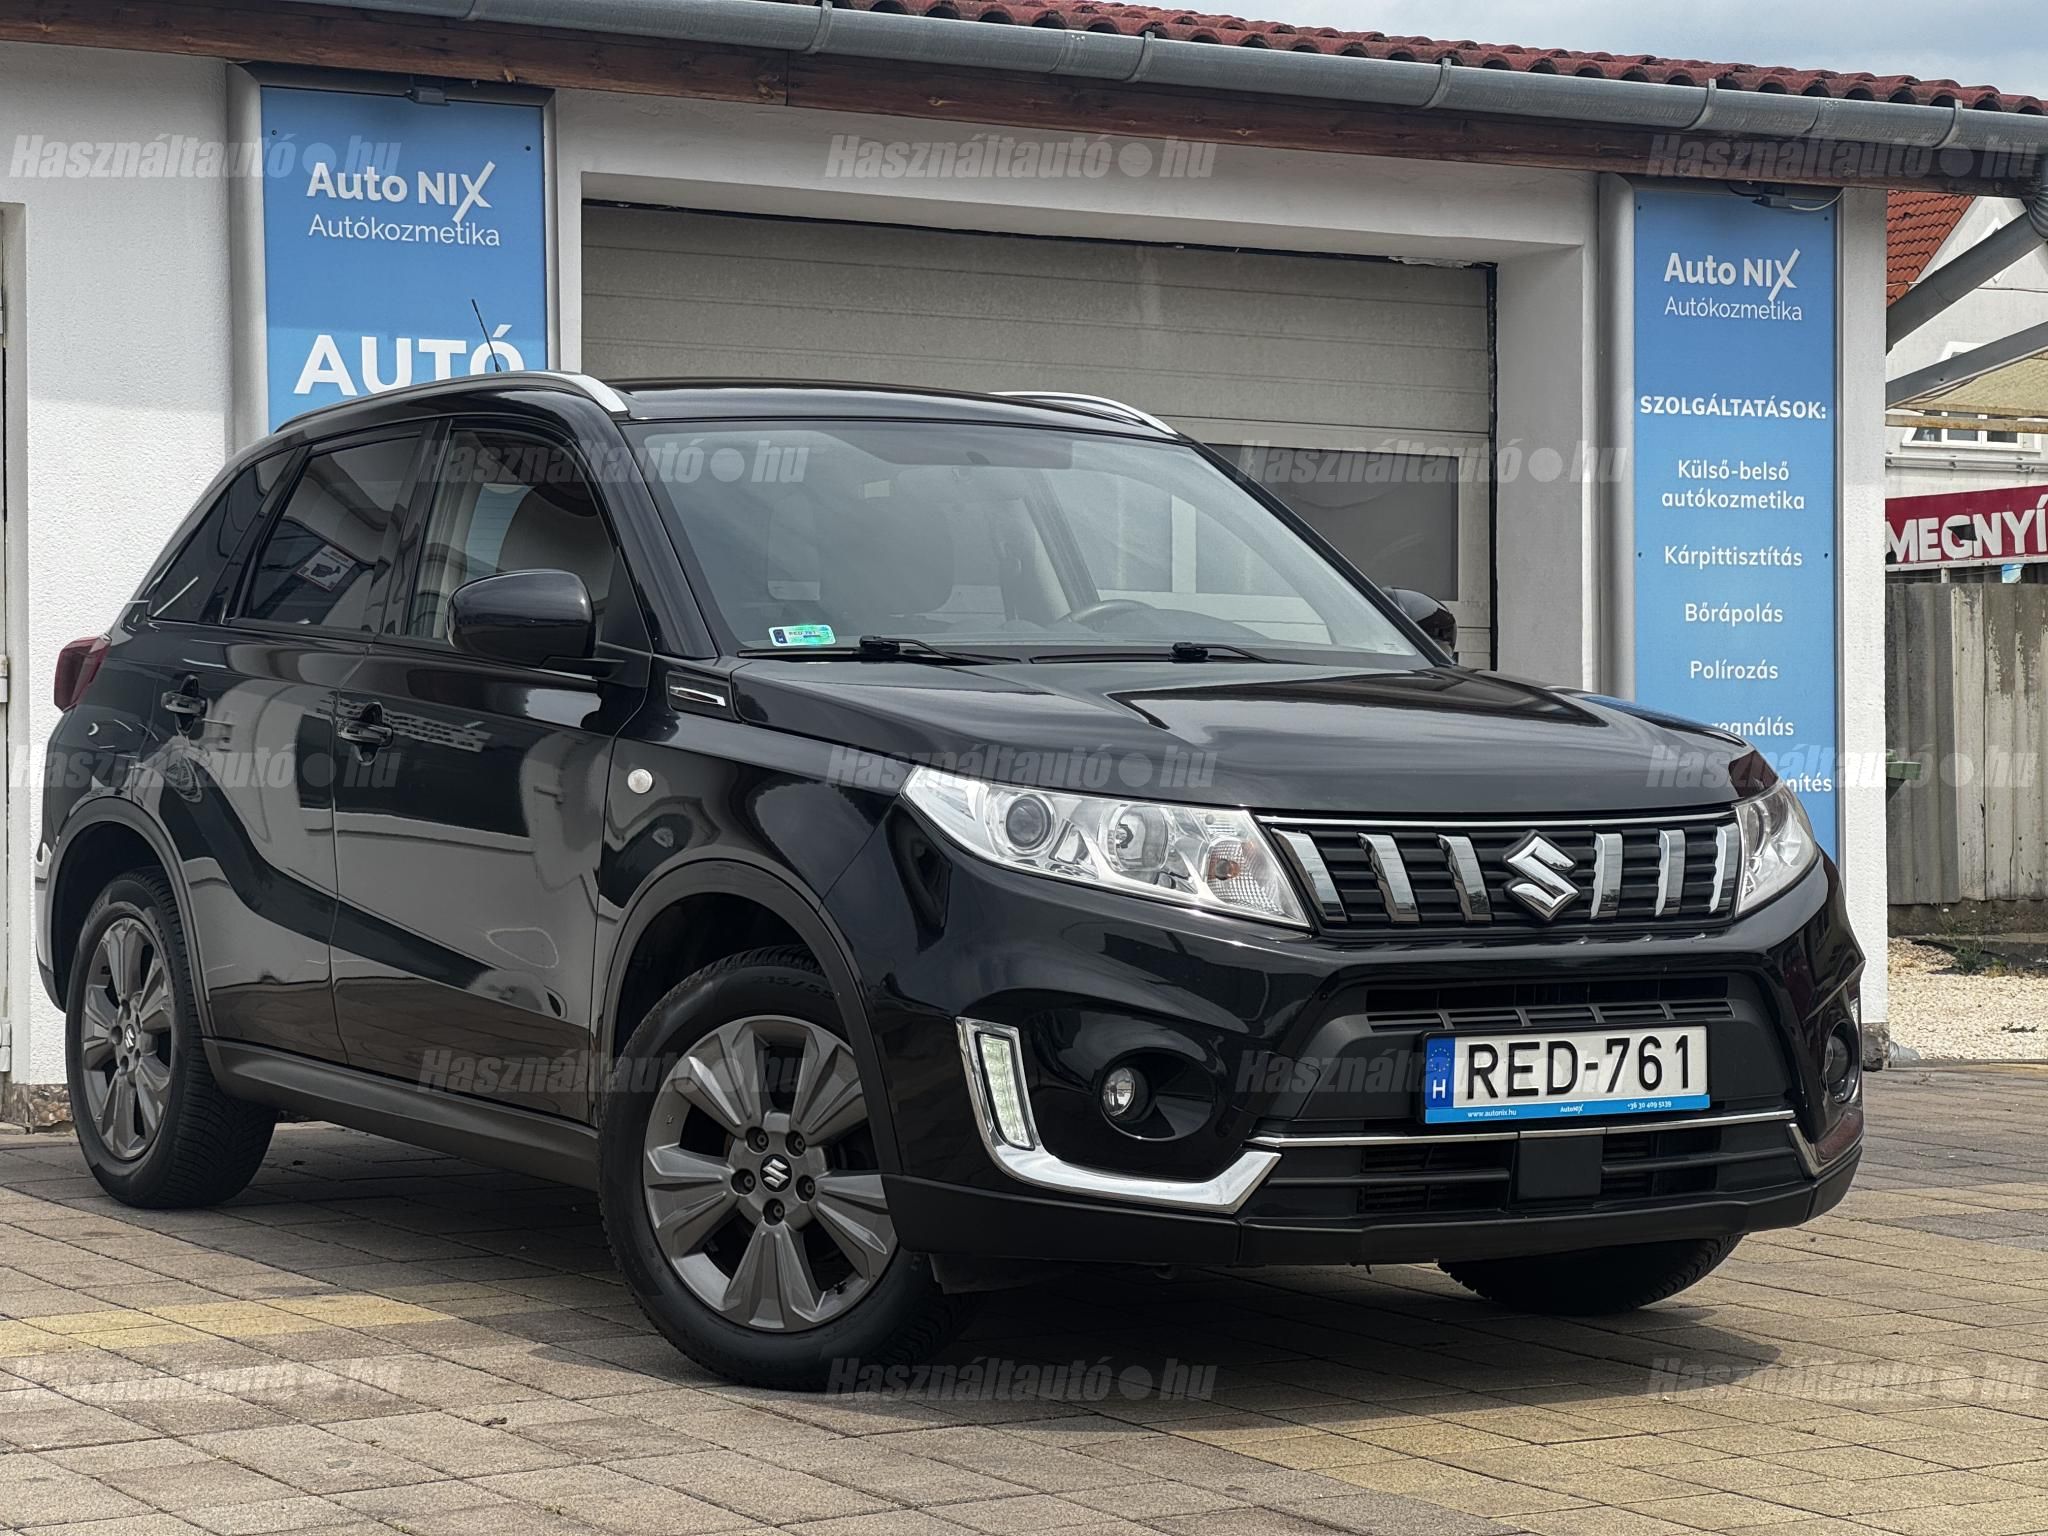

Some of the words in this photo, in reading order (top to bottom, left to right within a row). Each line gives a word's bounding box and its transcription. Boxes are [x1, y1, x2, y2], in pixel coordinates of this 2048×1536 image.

[306, 162, 408, 203] Auto
[417, 160, 496, 224] NIX
[308, 214, 501, 246] Autókozmetika
[1663, 252, 1737, 286] Auto
[1743, 248, 1801, 301] NIX
[1664, 295, 1803, 321] Autókozmetika
[293, 324, 525, 396] AUTÓ
[1640, 393, 1827, 419] SZOLGÁLTATÁSOK:
[1678, 459, 1790, 481] Külső-belső
[1661, 487, 1806, 510] autókozmetika
[1664, 544, 1804, 570] Kárpittisztítás
[1685, 602, 1784, 627] Bőrápolás
[1690, 658, 1779, 680] Polírozás
[1466, 1034, 1690, 1101] RED-761
[1432, 1079, 1447, 1100] H
[1467, 1108, 1518, 1118] www.autonix.hu
